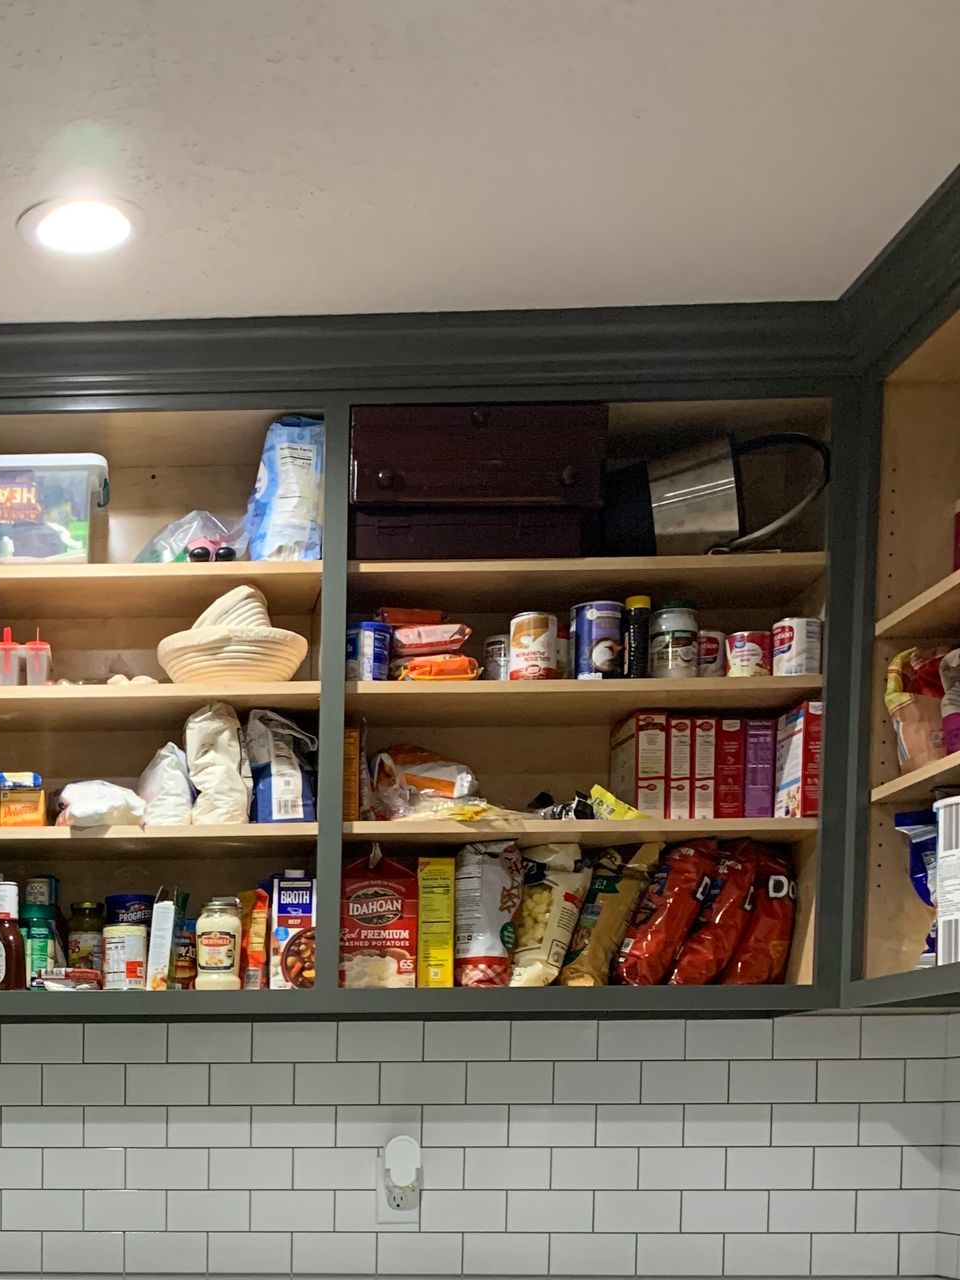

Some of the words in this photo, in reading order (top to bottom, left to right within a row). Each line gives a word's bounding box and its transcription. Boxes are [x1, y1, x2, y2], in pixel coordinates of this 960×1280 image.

[280, 890, 310, 904] BROTH
[348, 899, 402, 916] IDAHOAN
[360, 929, 410, 939] PREMIUM
[399, 959, 414, 969] 65
